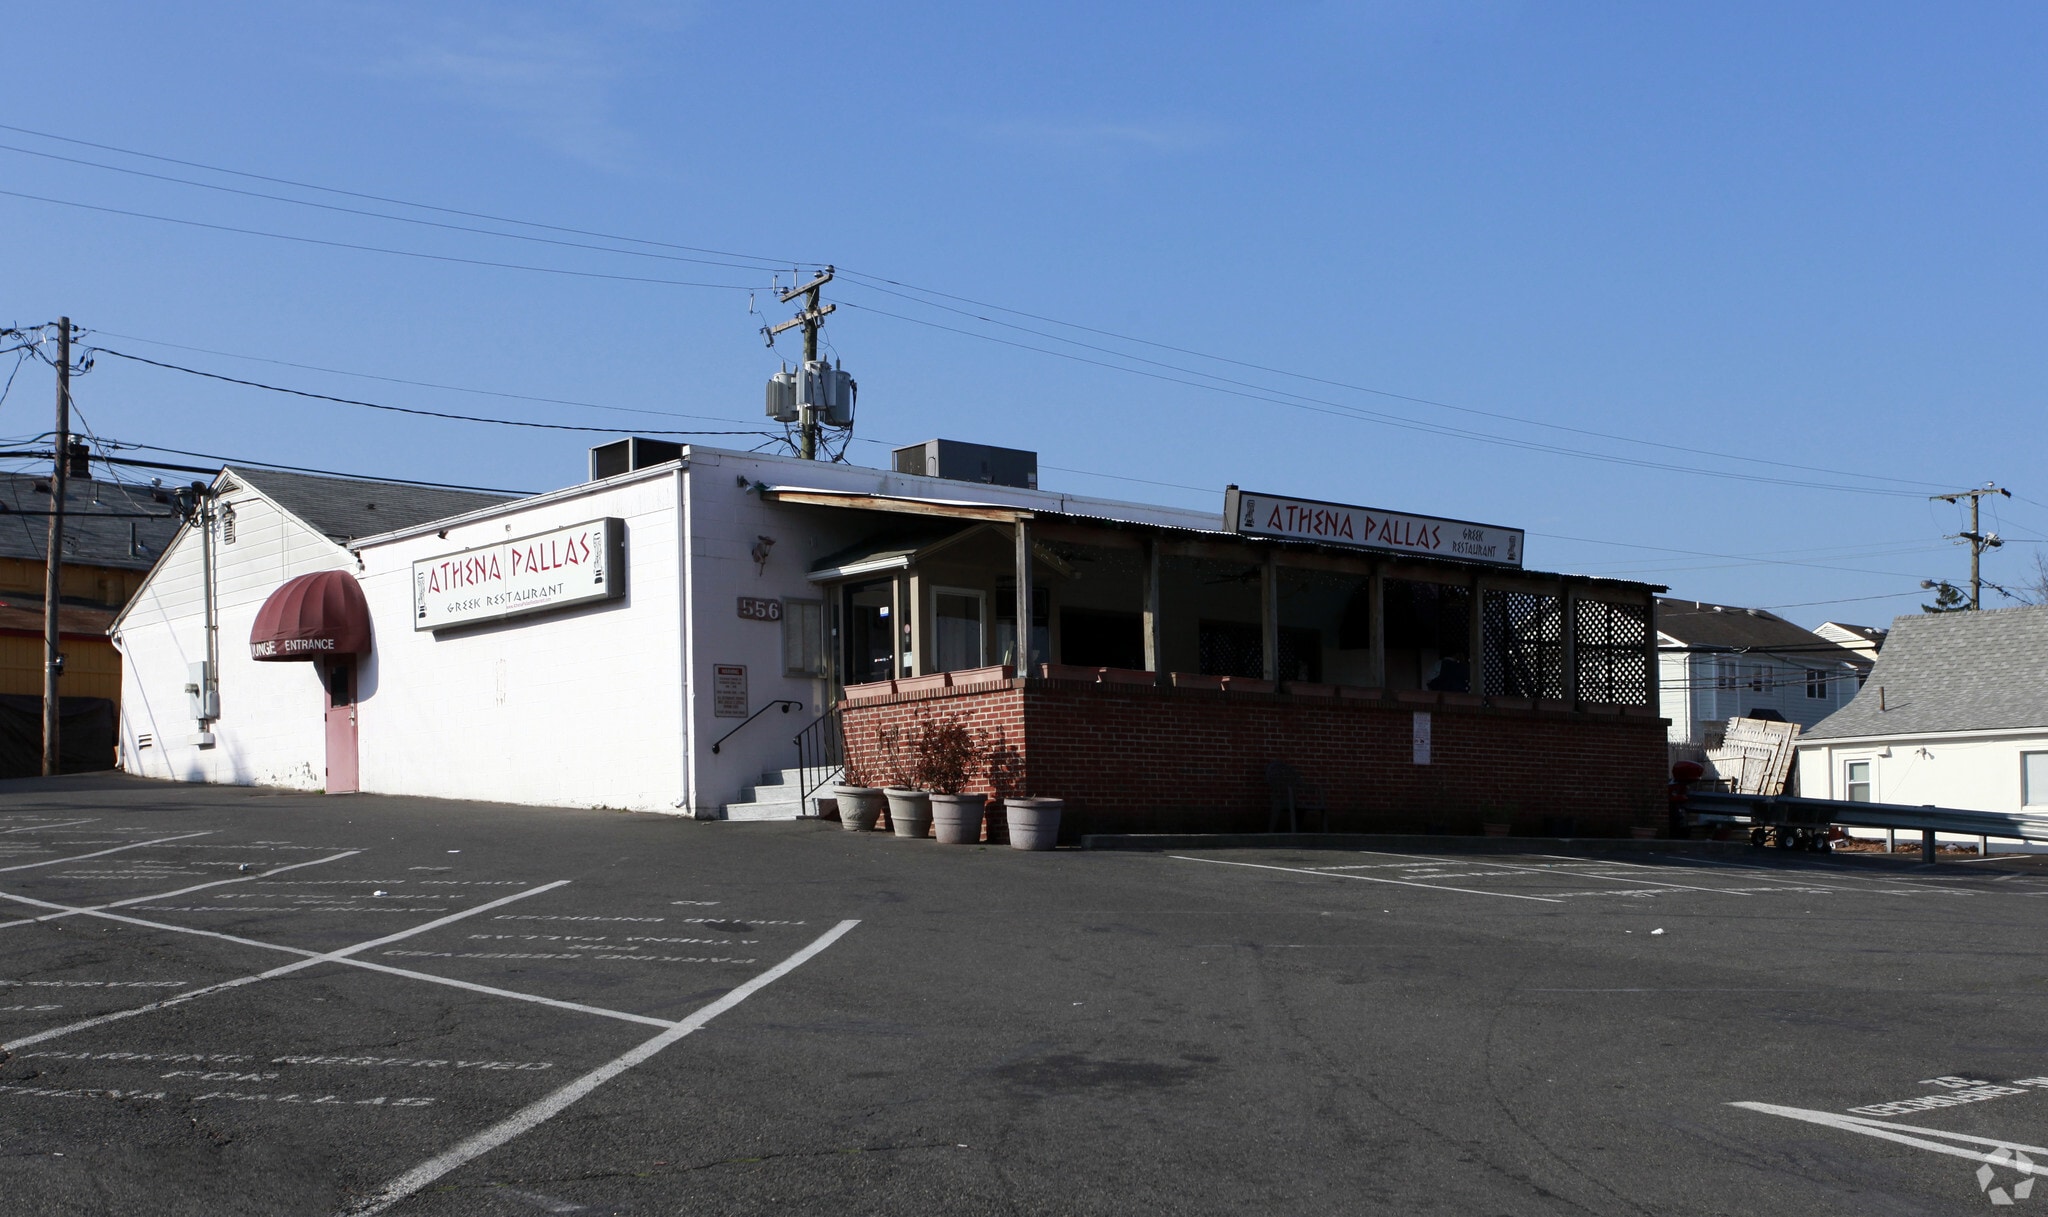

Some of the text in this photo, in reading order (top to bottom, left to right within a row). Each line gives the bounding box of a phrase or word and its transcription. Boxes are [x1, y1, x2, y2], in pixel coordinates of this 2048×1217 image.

[1267, 503, 1441, 550] ATHENA PALLAS
[1462, 527, 1484, 541] GREEK
[1452, 540, 1497, 558] RESTAURANT
[428, 532, 590, 594] ATHENA PALLAS
[446, 597, 481, 613] GREEK
[486, 582, 565, 607] RESTAURANT
[743, 600, 779, 620] 556
[285, 639, 335, 651] ENTRANCE
[467, 934, 607, 942] PALLAS
[271, 1055, 554, 1070] RESERVED
[160, 1070, 280, 1082] FOR
[193, 1091, 436, 1107] PALLAS
